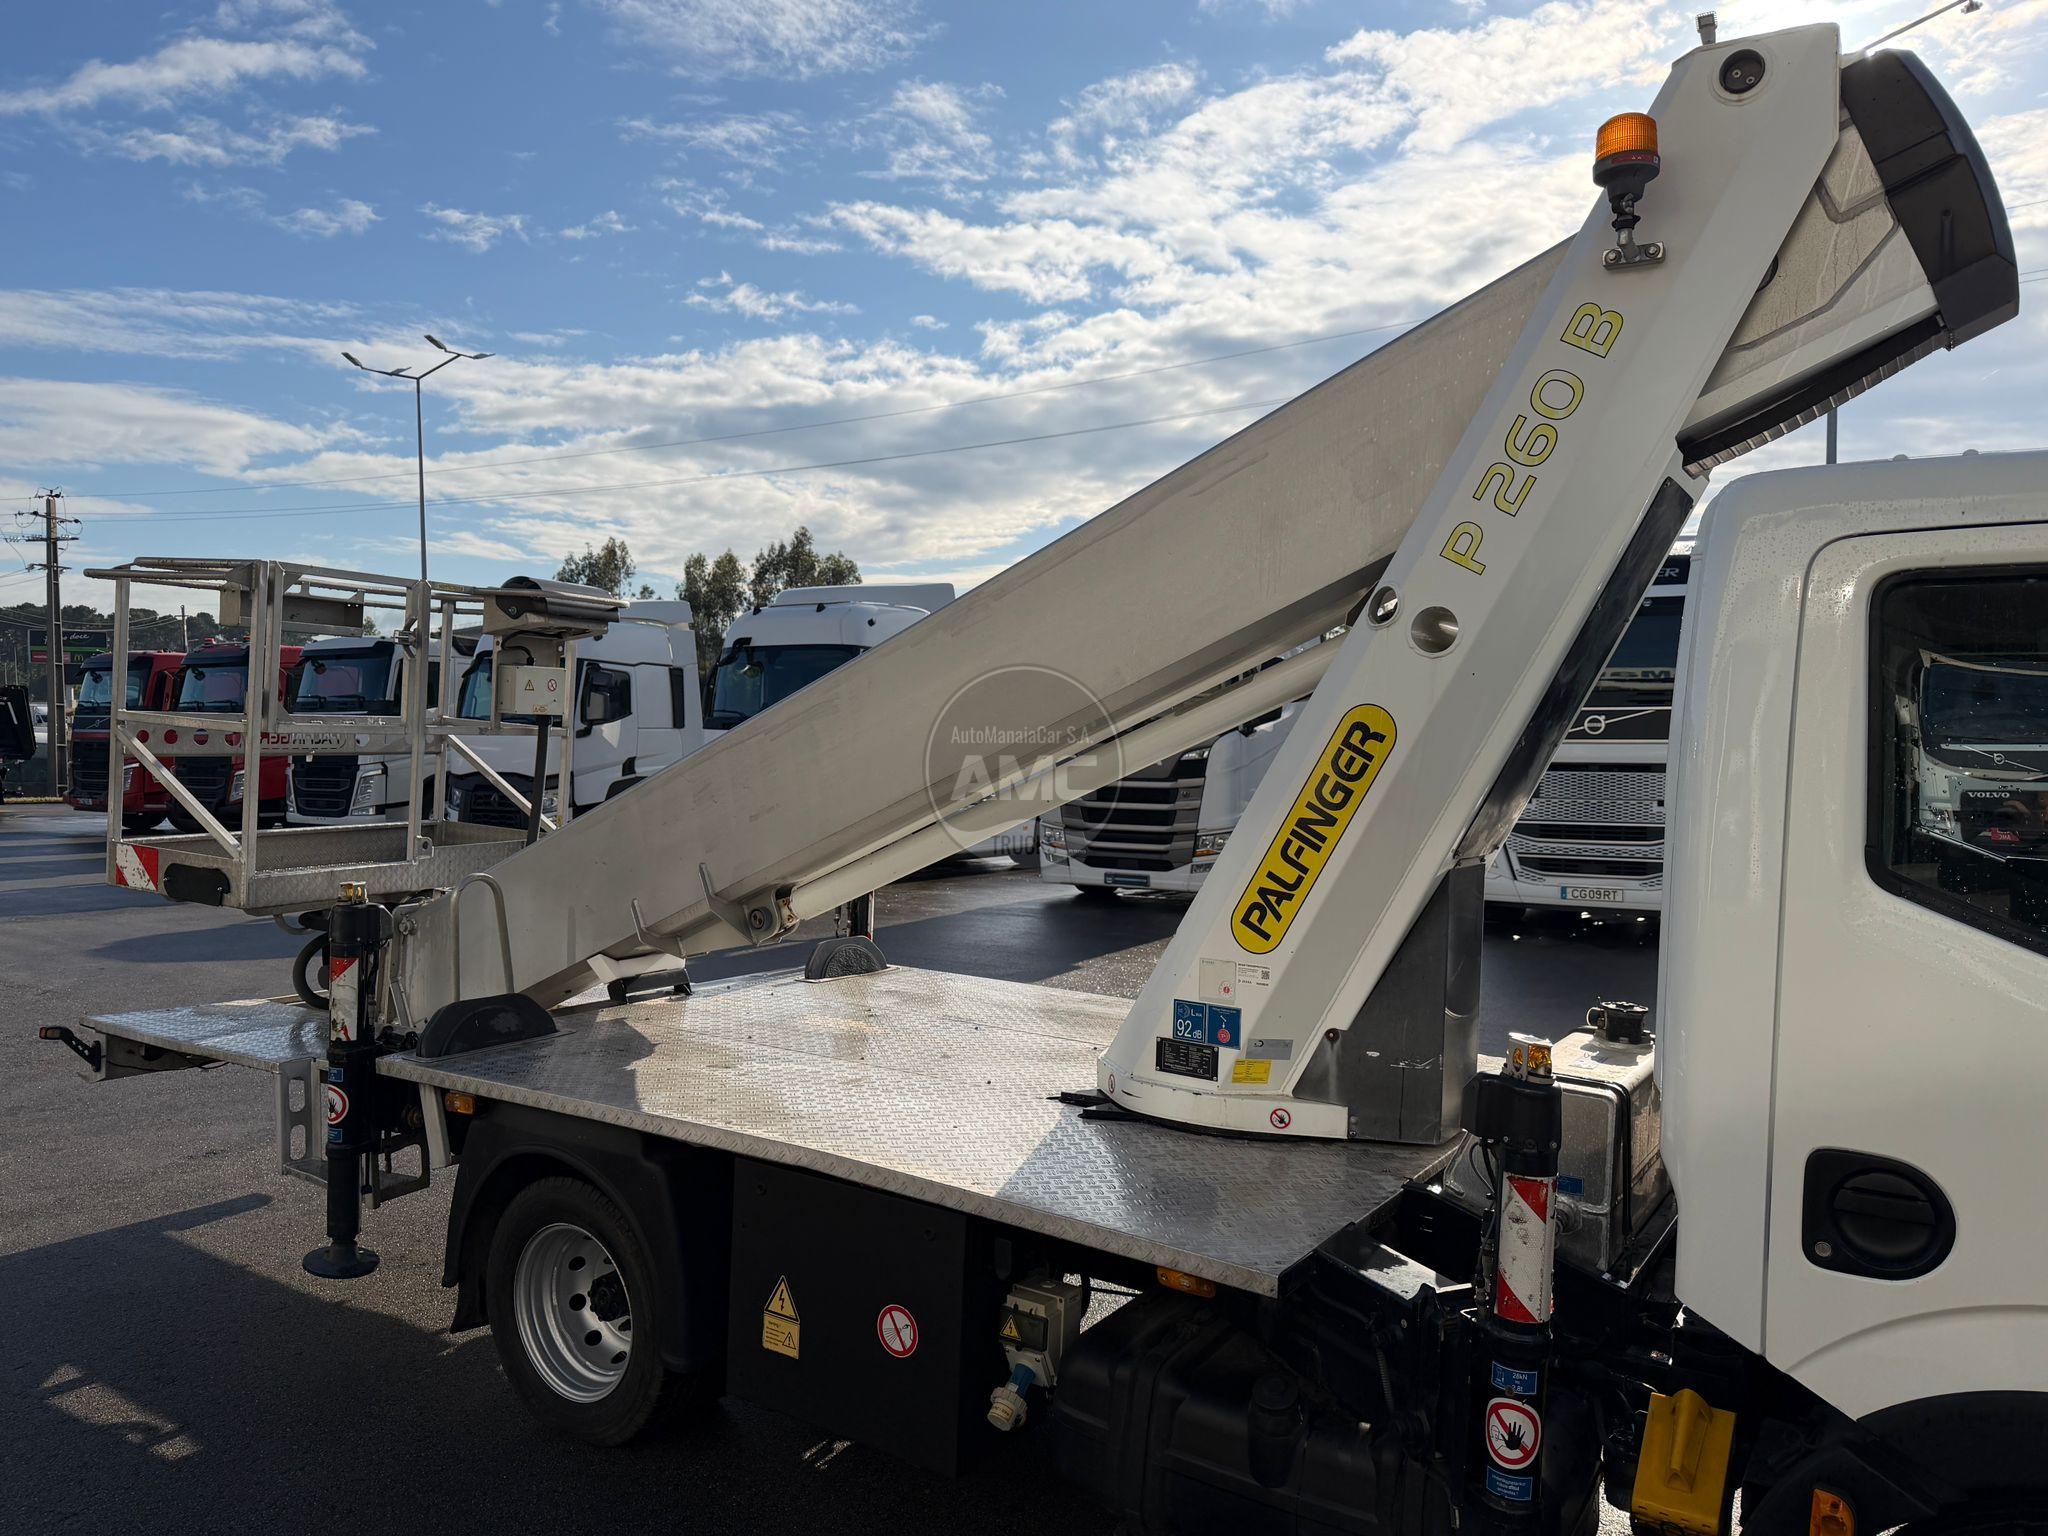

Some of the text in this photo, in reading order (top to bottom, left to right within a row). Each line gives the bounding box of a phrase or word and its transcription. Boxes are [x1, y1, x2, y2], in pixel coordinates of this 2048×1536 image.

[1440, 302, 1624, 576] P 260 B
[1967, 791, 2010, 799] VOLVO
[1239, 720, 1387, 942] PALFINGER
[1571, 888, 1618, 901] CG09RT
[1177, 1019, 1192, 1037] 92
[1192, 1029, 1203, 1039] dB
